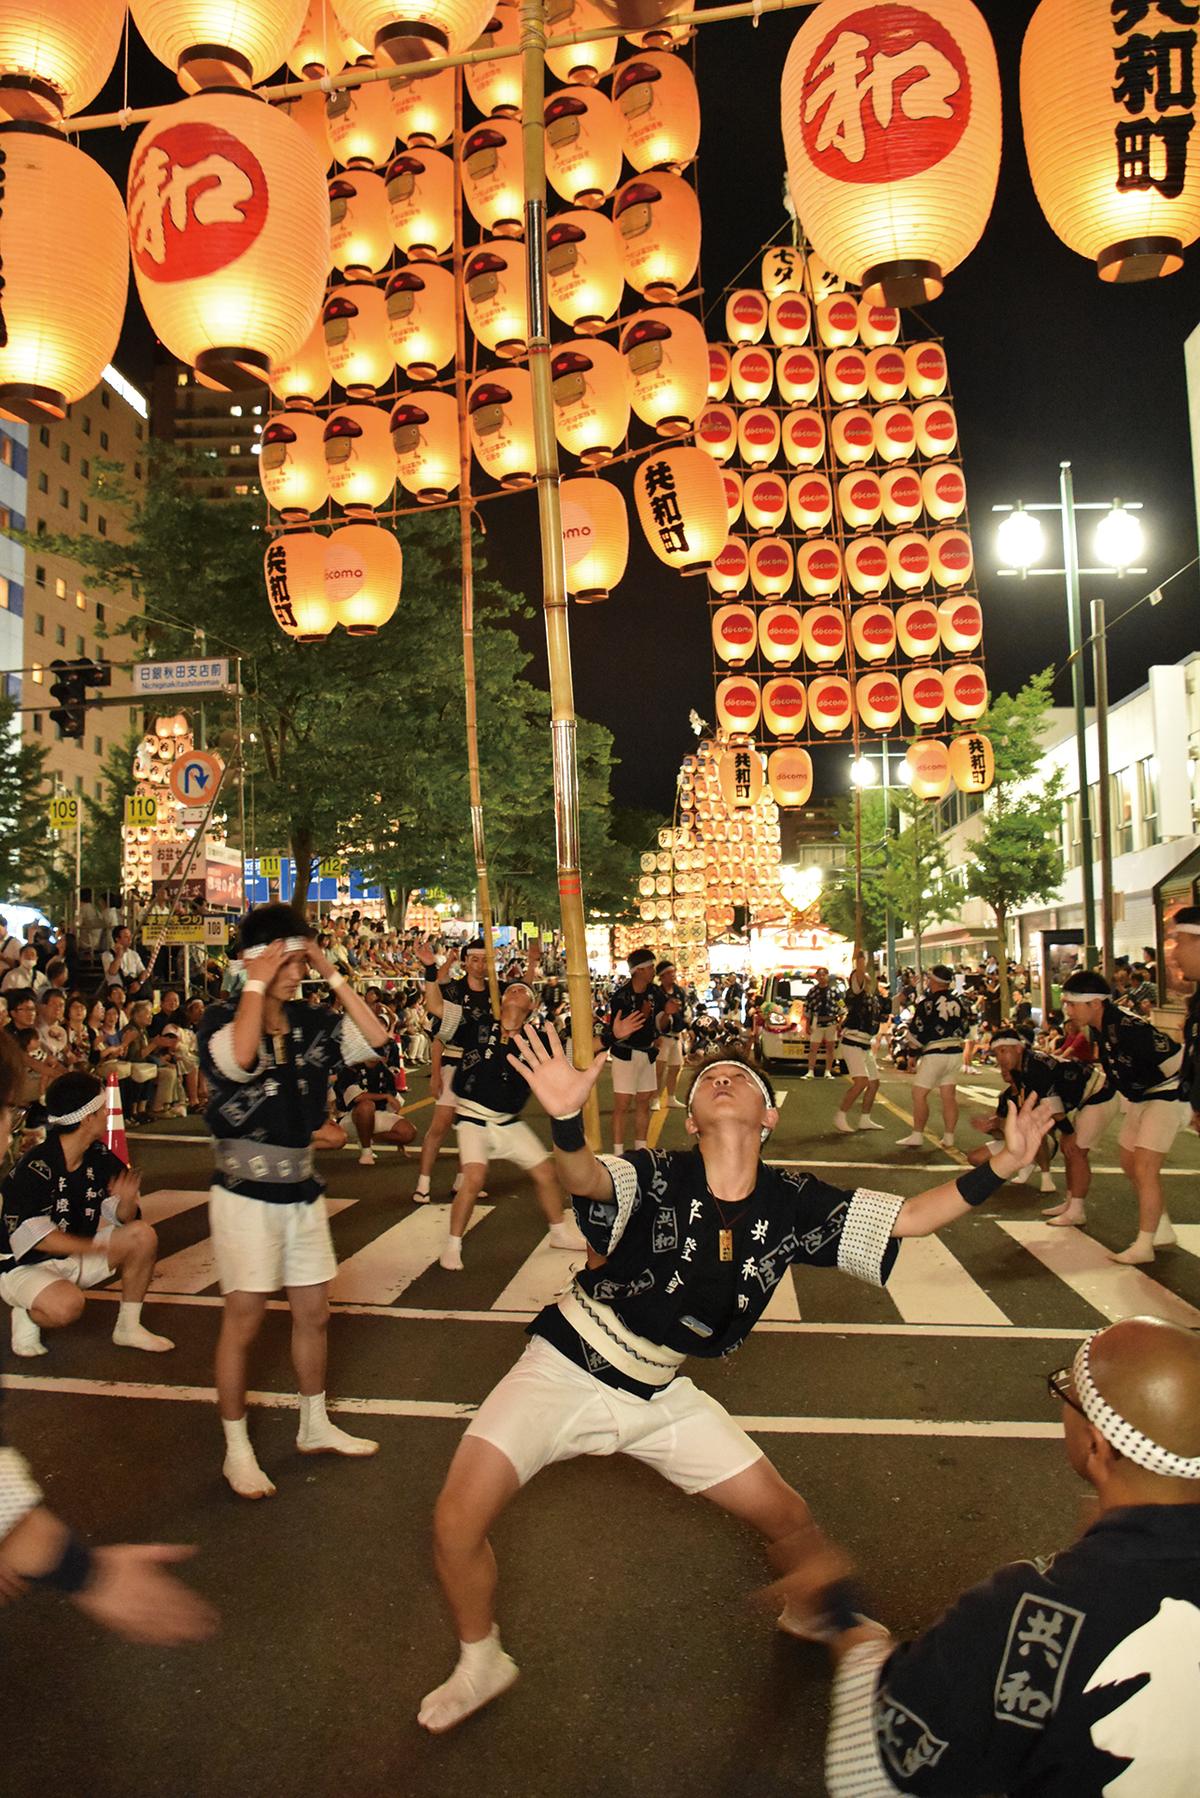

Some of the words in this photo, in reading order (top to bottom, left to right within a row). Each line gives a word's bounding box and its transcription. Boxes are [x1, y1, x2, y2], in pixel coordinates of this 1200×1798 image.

[645, 461, 689, 553] 共和町
[141, 664, 221, 680] 日銀秋田支店前
[735, 753, 751, 798] 共和町
[967, 739, 986, 784] 共和町
[53, 801, 78, 818] 109
[130, 799, 156, 816] 110
[738, 1219, 770, 1312] 共和町
[1000, 1608, 1064, 1716] 共和
